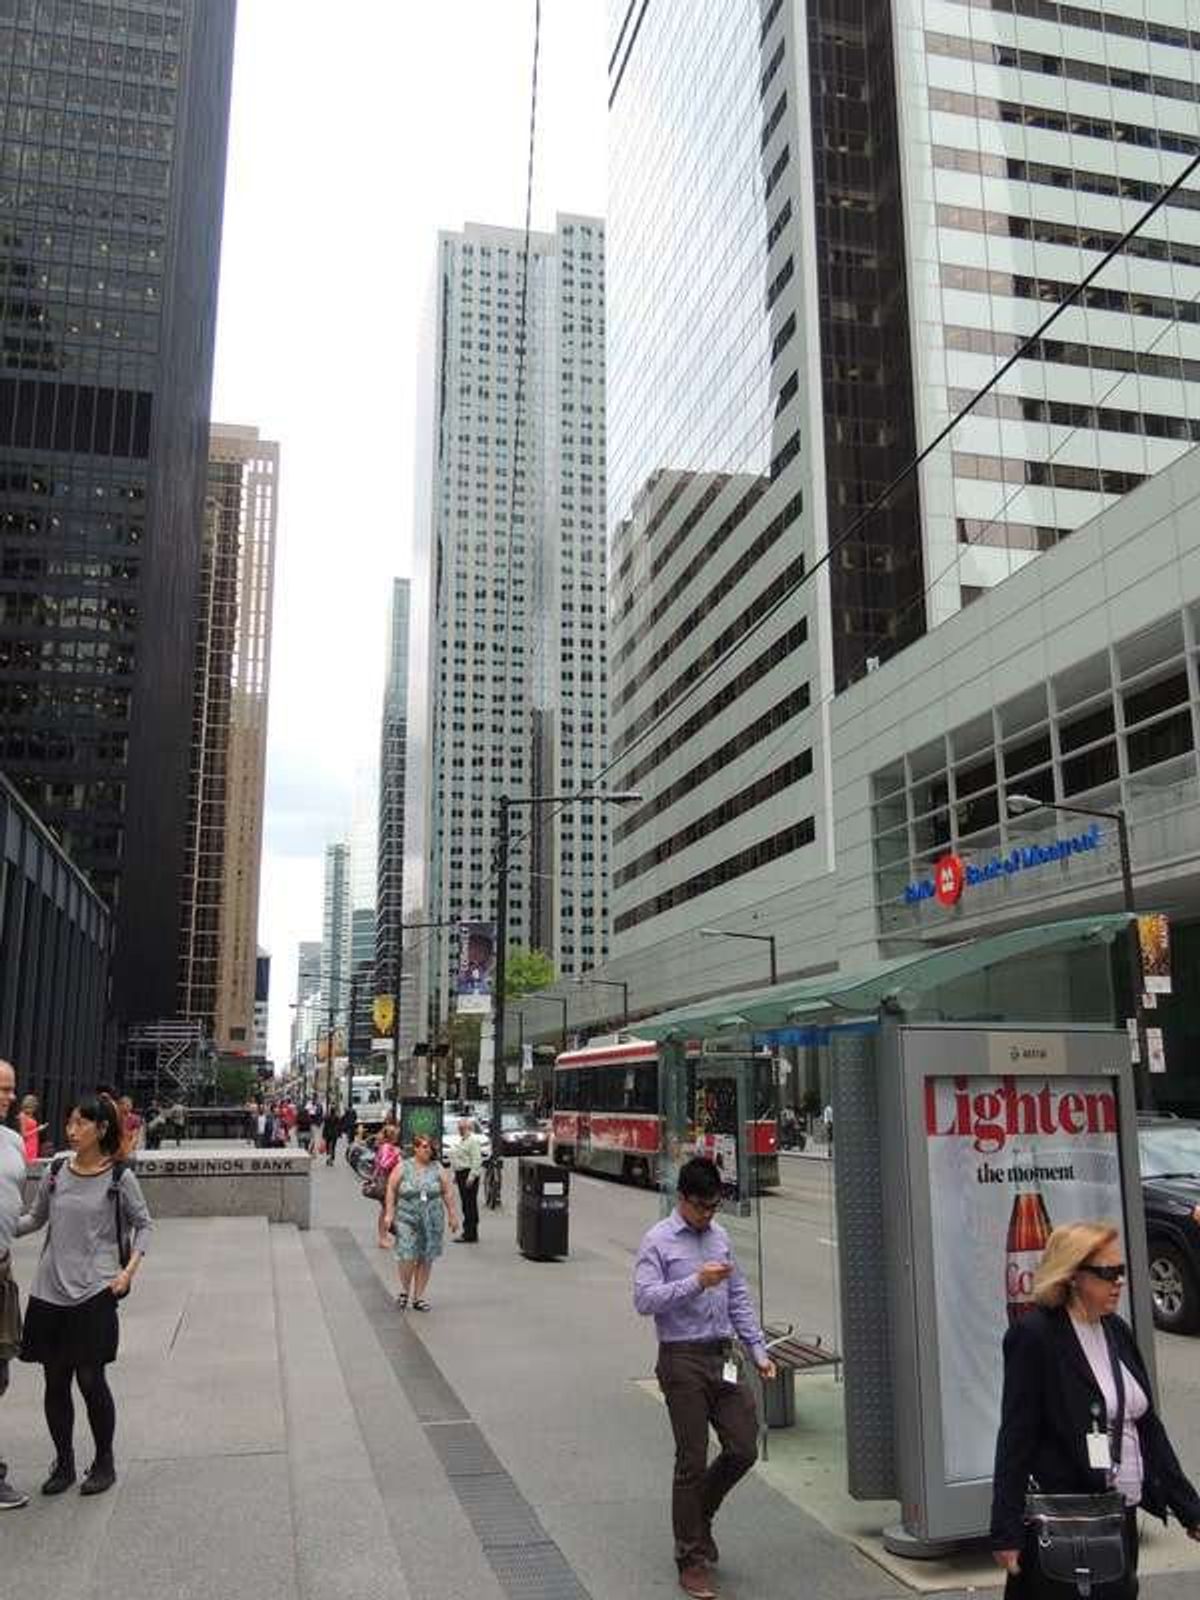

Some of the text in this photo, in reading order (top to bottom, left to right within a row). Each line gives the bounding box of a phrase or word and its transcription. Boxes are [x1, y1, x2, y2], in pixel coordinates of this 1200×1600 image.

[924, 1075, 1118, 1153] Lighten
[131, 1159, 292, 1173] TO-DOMINION BANK
[977, 1163, 1074, 1183] the moment
